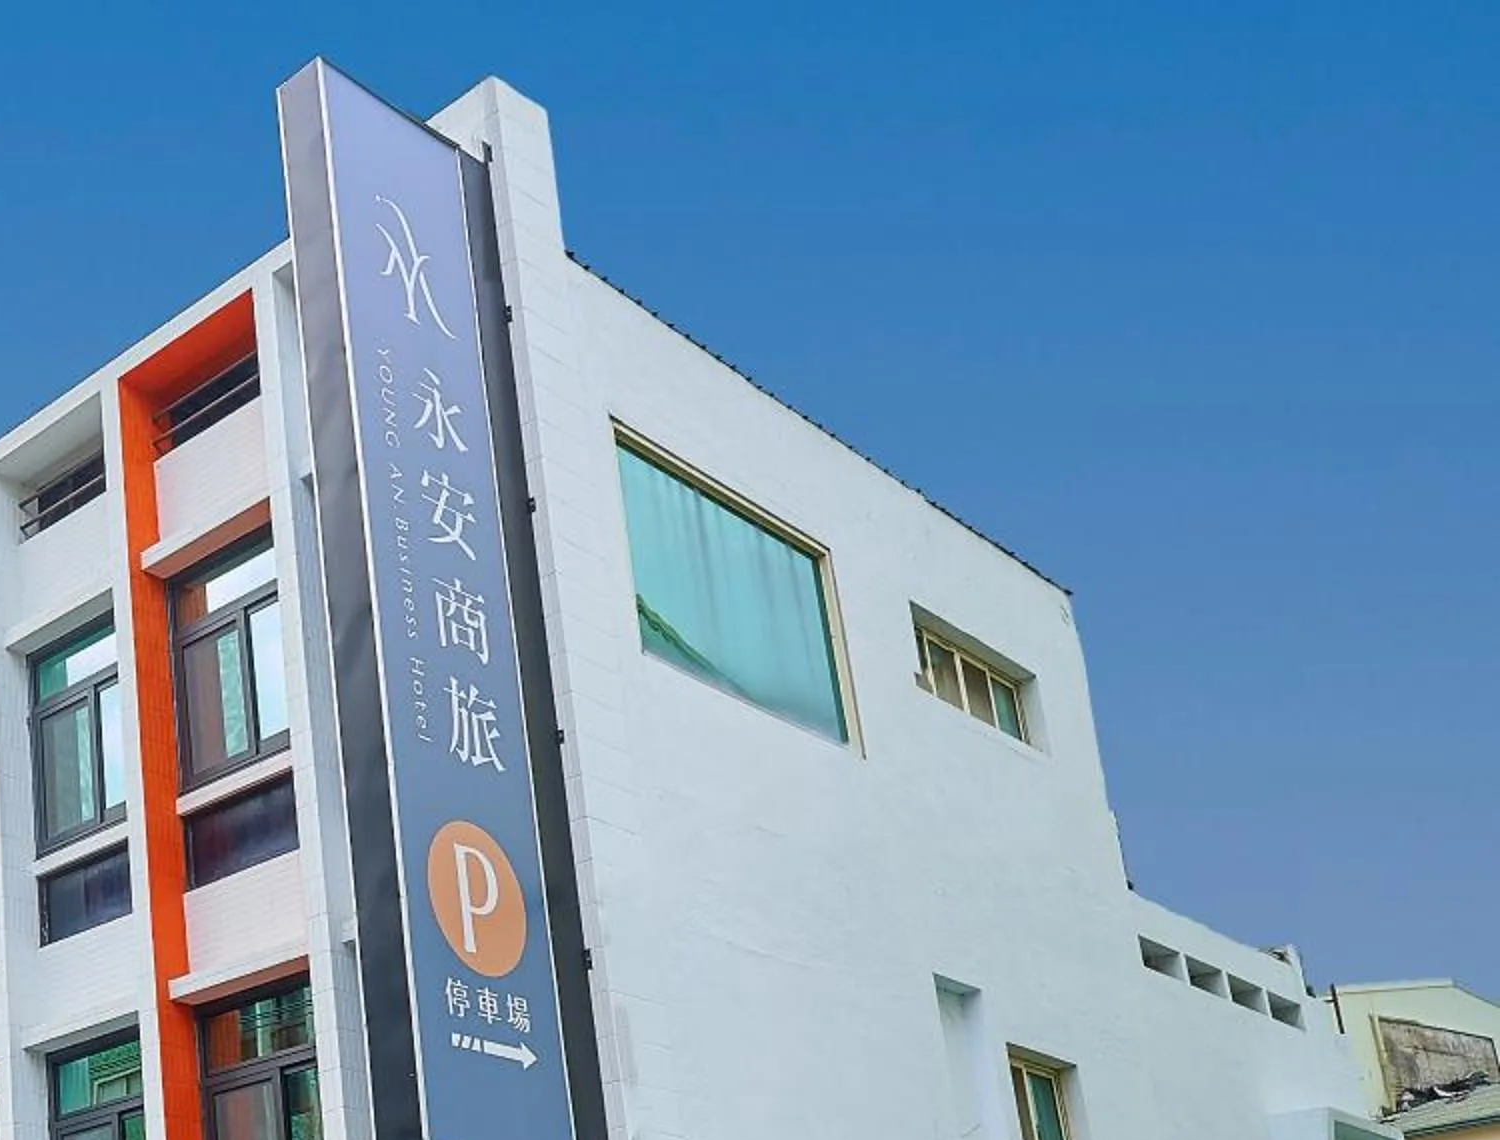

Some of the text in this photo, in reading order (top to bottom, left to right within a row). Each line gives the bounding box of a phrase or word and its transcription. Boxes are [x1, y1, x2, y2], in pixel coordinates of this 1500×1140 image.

[376, 346, 401, 449] YOUNG
[394, 516, 421, 640] Business
[409, 656, 435, 745] Hotel
[411, 367, 507, 772] 永安商旅
[445, 977, 532, 1034] 停車場
[453, 842, 499, 954] P
